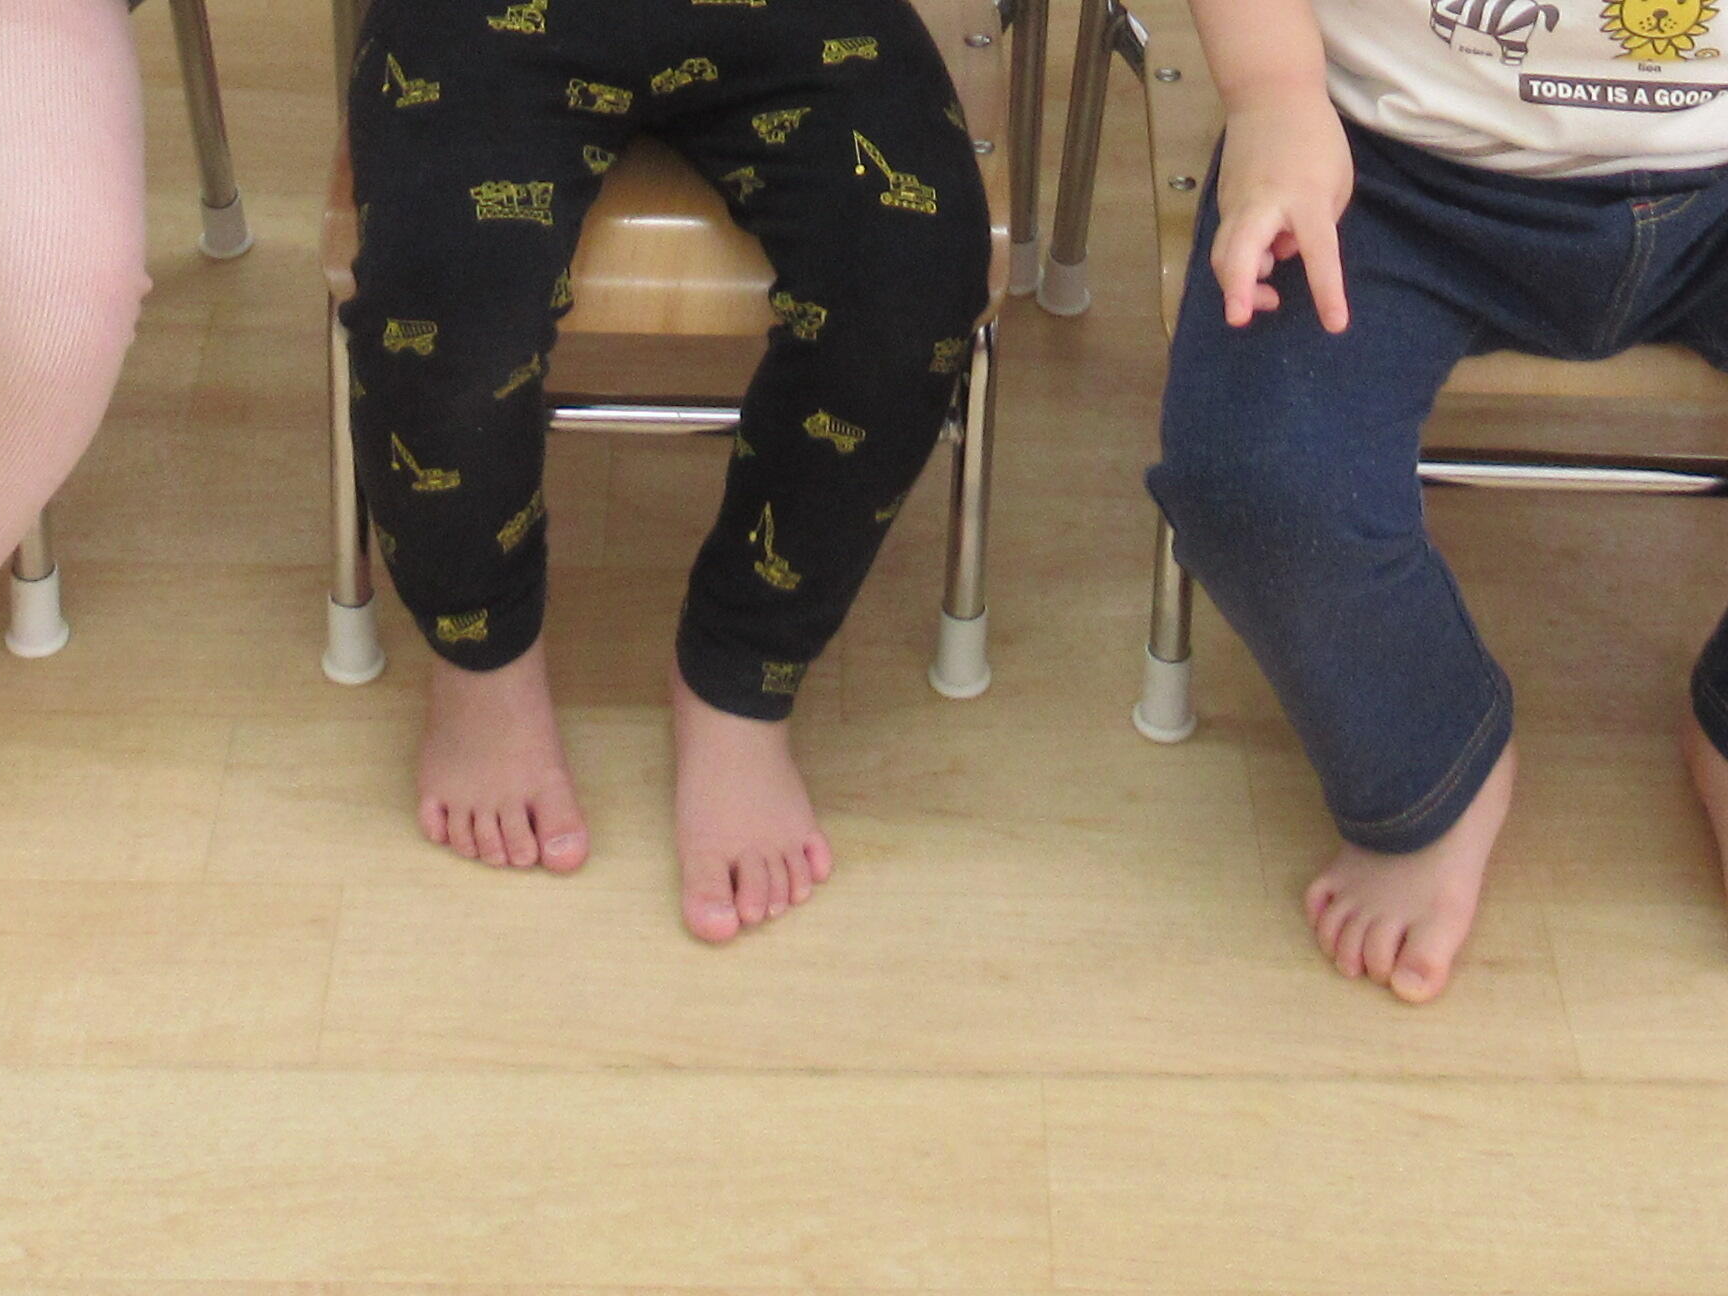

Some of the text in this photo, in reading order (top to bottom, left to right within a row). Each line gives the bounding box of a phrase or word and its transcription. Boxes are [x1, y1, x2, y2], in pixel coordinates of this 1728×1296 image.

[1528, 79, 1602, 102] TODAY
[1606, 86, 1629, 105] IS
[1633, 87, 1650, 106] A
[1654, 88, 1713, 107] GOOD
